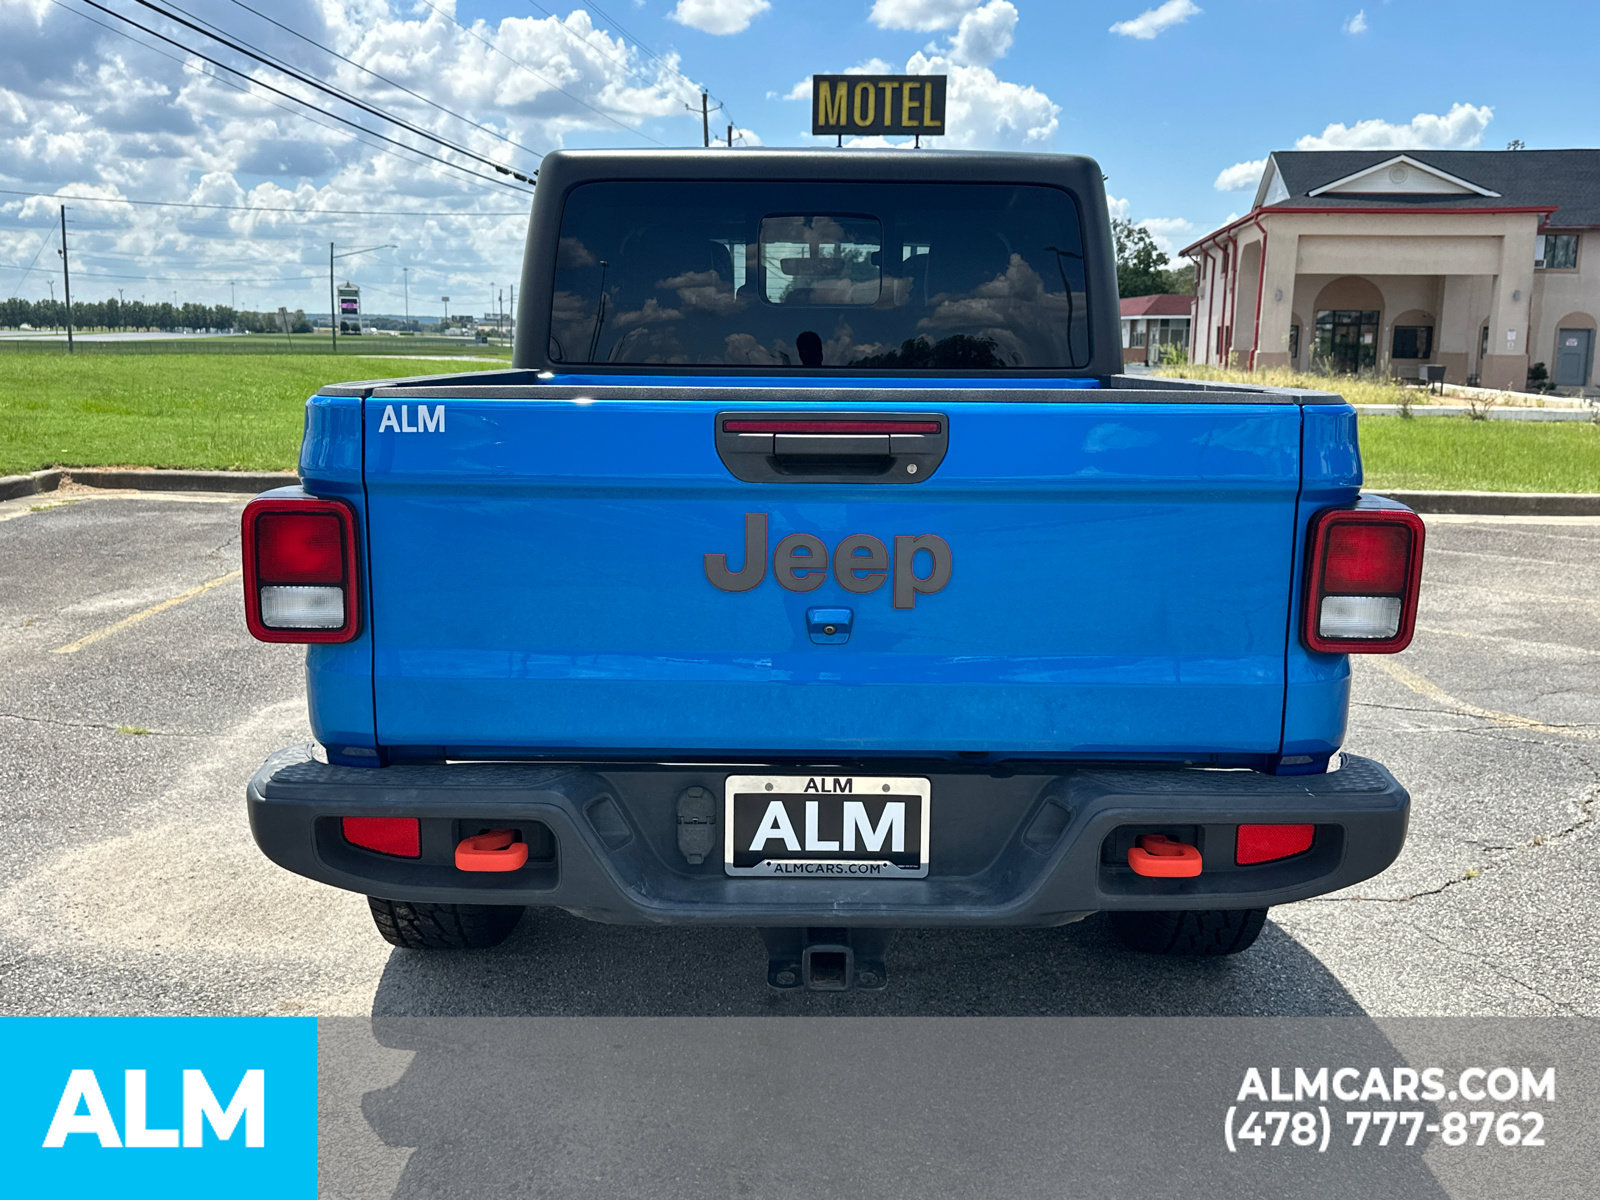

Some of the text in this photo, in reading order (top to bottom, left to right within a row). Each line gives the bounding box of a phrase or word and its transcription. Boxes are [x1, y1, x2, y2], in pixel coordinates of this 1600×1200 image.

[818, 80, 942, 127] MOTEL
[378, 404, 446, 433] ALM
[704, 512, 952, 609] Jeep
[803, 777, 853, 793] ALM
[748, 800, 906, 852] ALM
[773, 862, 881, 875] ALMCARS.COM
